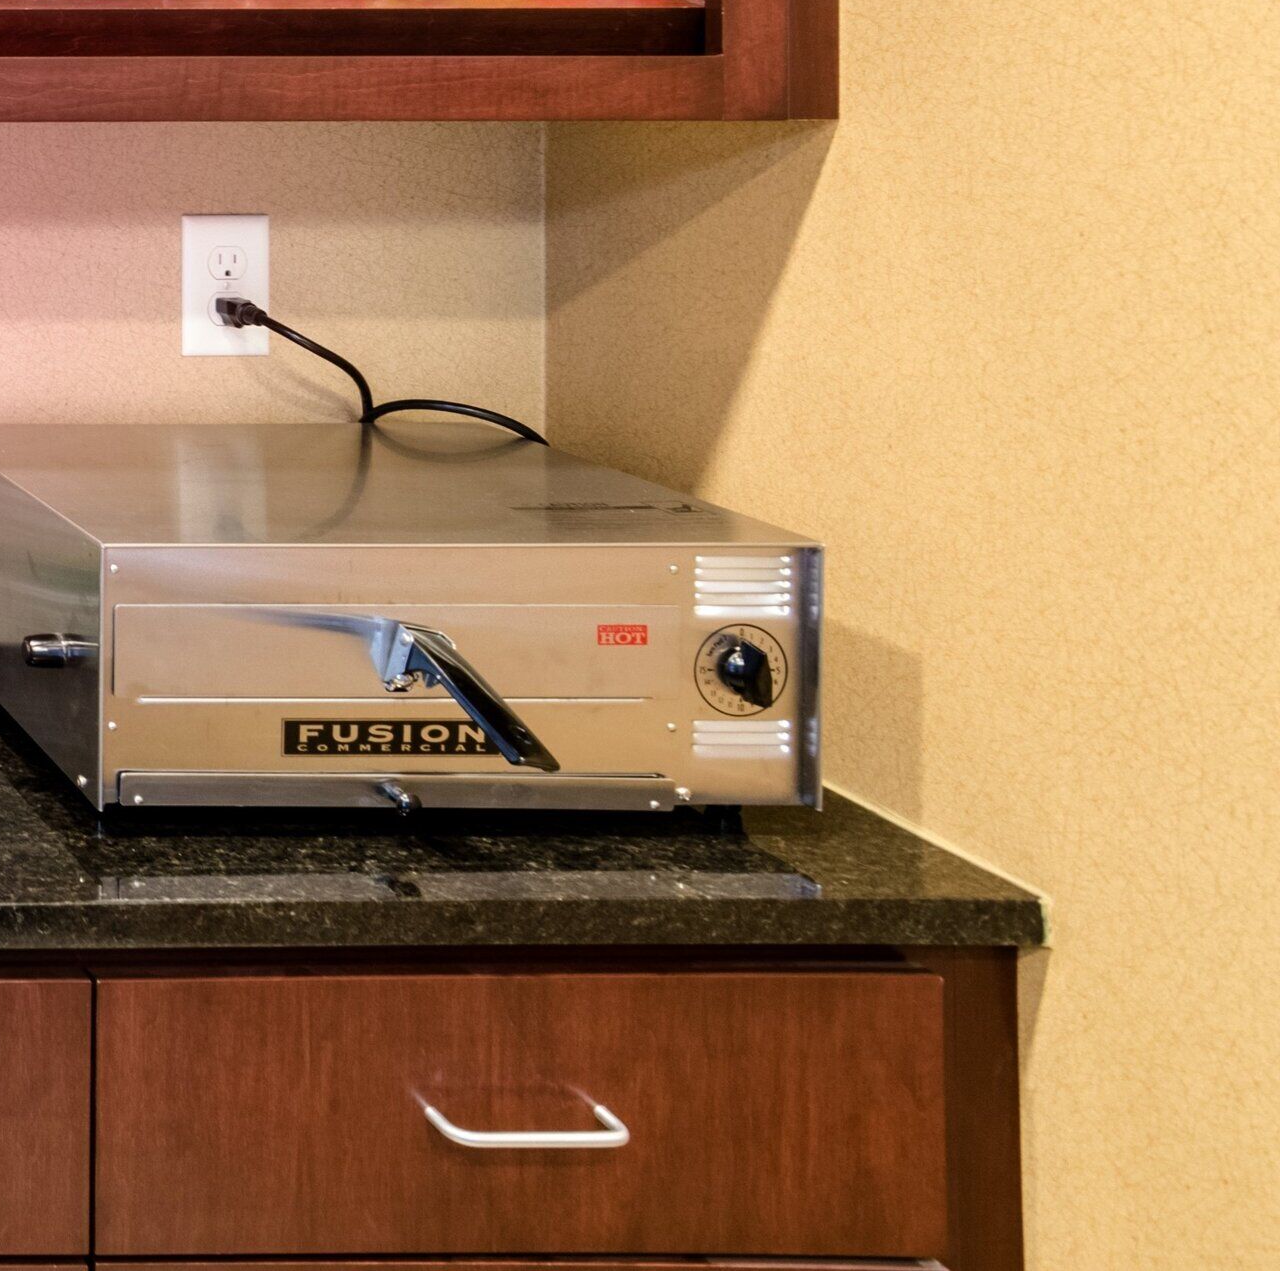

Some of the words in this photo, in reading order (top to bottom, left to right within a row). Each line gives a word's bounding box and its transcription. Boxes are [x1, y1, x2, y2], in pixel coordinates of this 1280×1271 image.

[600, 632, 646, 645] HOT
[298, 724, 486, 744] FUSION
[297, 743, 486, 753] COMMERCIAL
